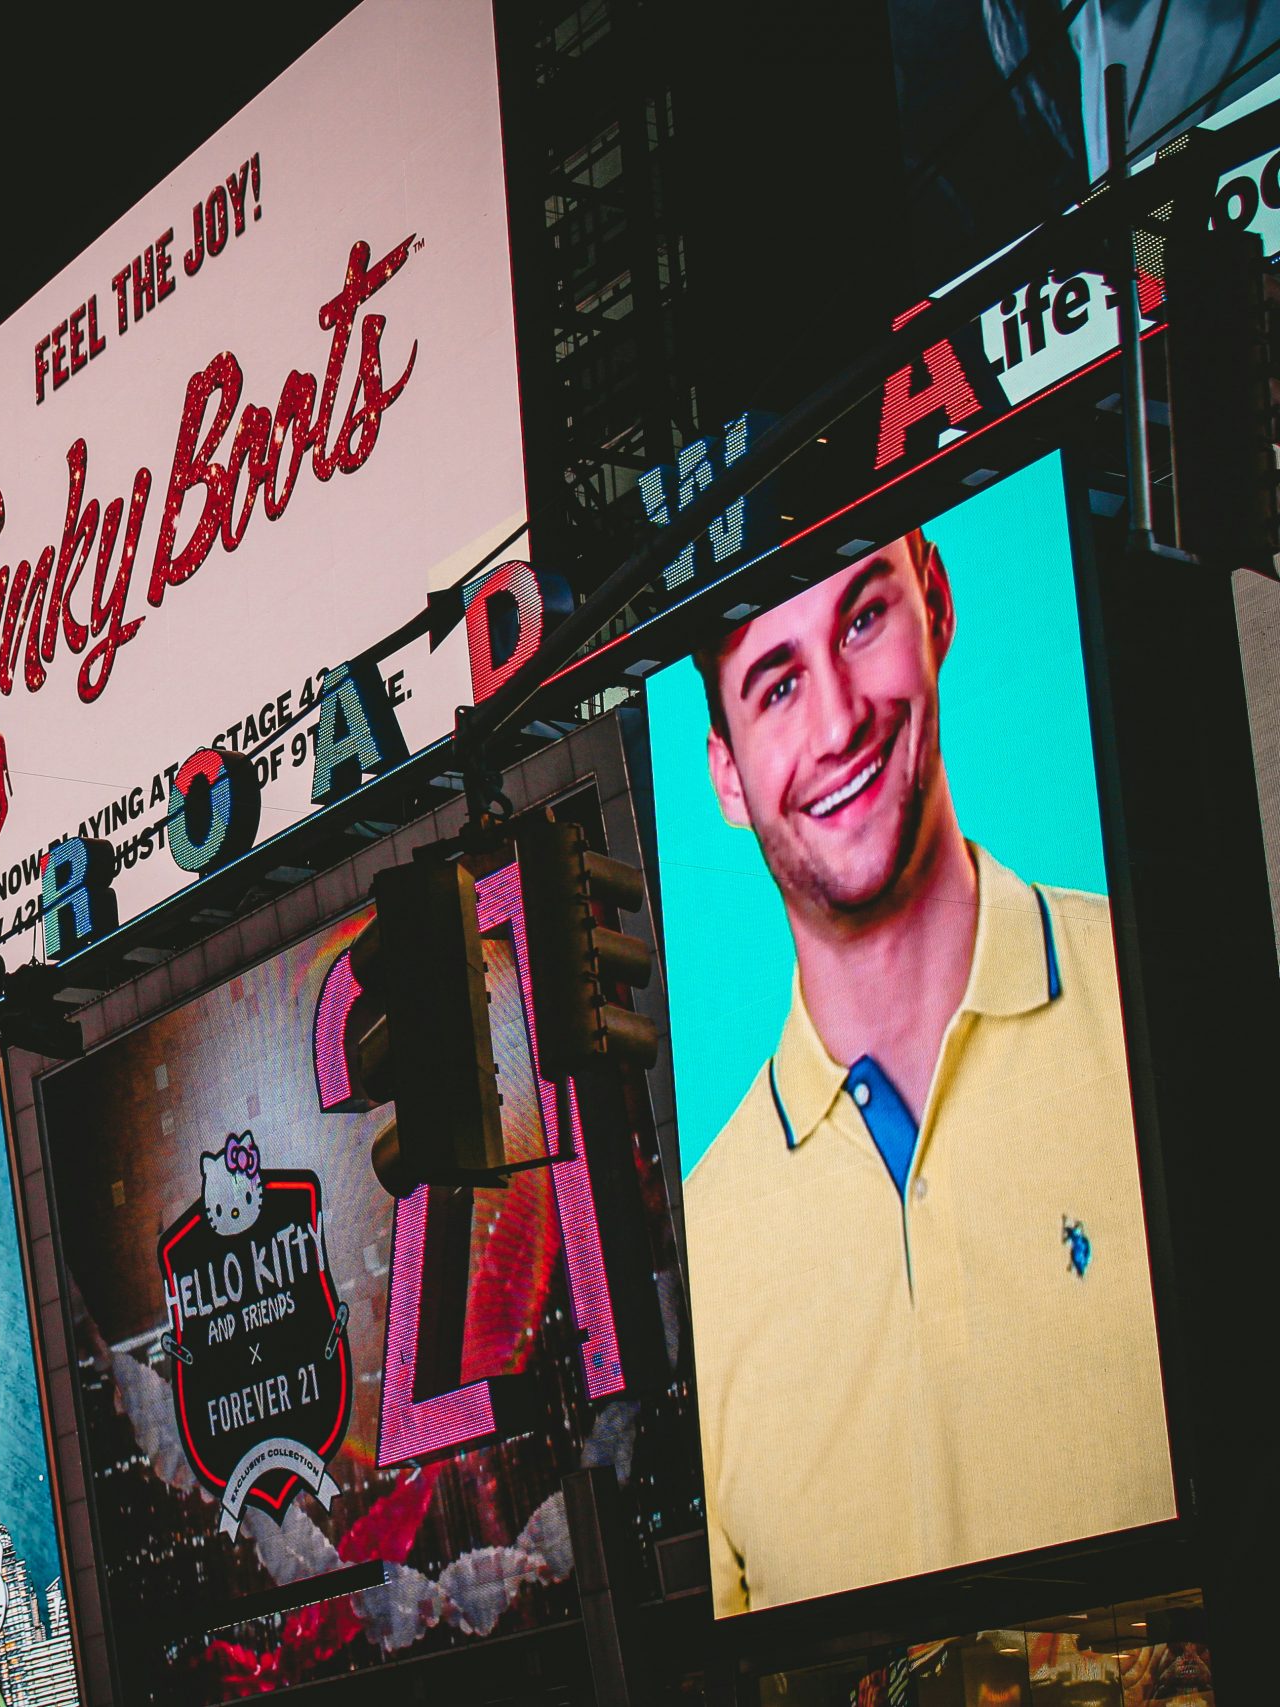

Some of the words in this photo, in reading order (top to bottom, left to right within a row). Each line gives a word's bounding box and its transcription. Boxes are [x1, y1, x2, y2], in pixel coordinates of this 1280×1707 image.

[34, 293, 107, 406] FEEL
[112, 227, 176, 337] THE
[184, 152, 262, 278] JOY!
[990, 266, 1091, 373] ife
[147, 232, 418, 608] Boots
[150, 761, 179, 809] AT
[211, 689, 293, 753] STAGE
[164, 1252, 243, 1332] HELLO
[208, 1314, 237, 1346] AND
[207, 1373, 292, 1436] FOREVER
[297, 1363, 321, 1412] 21
[230, 1451, 267, 1503] EXCLUSIVE
[266, 1448, 321, 1478] COLLECTION
